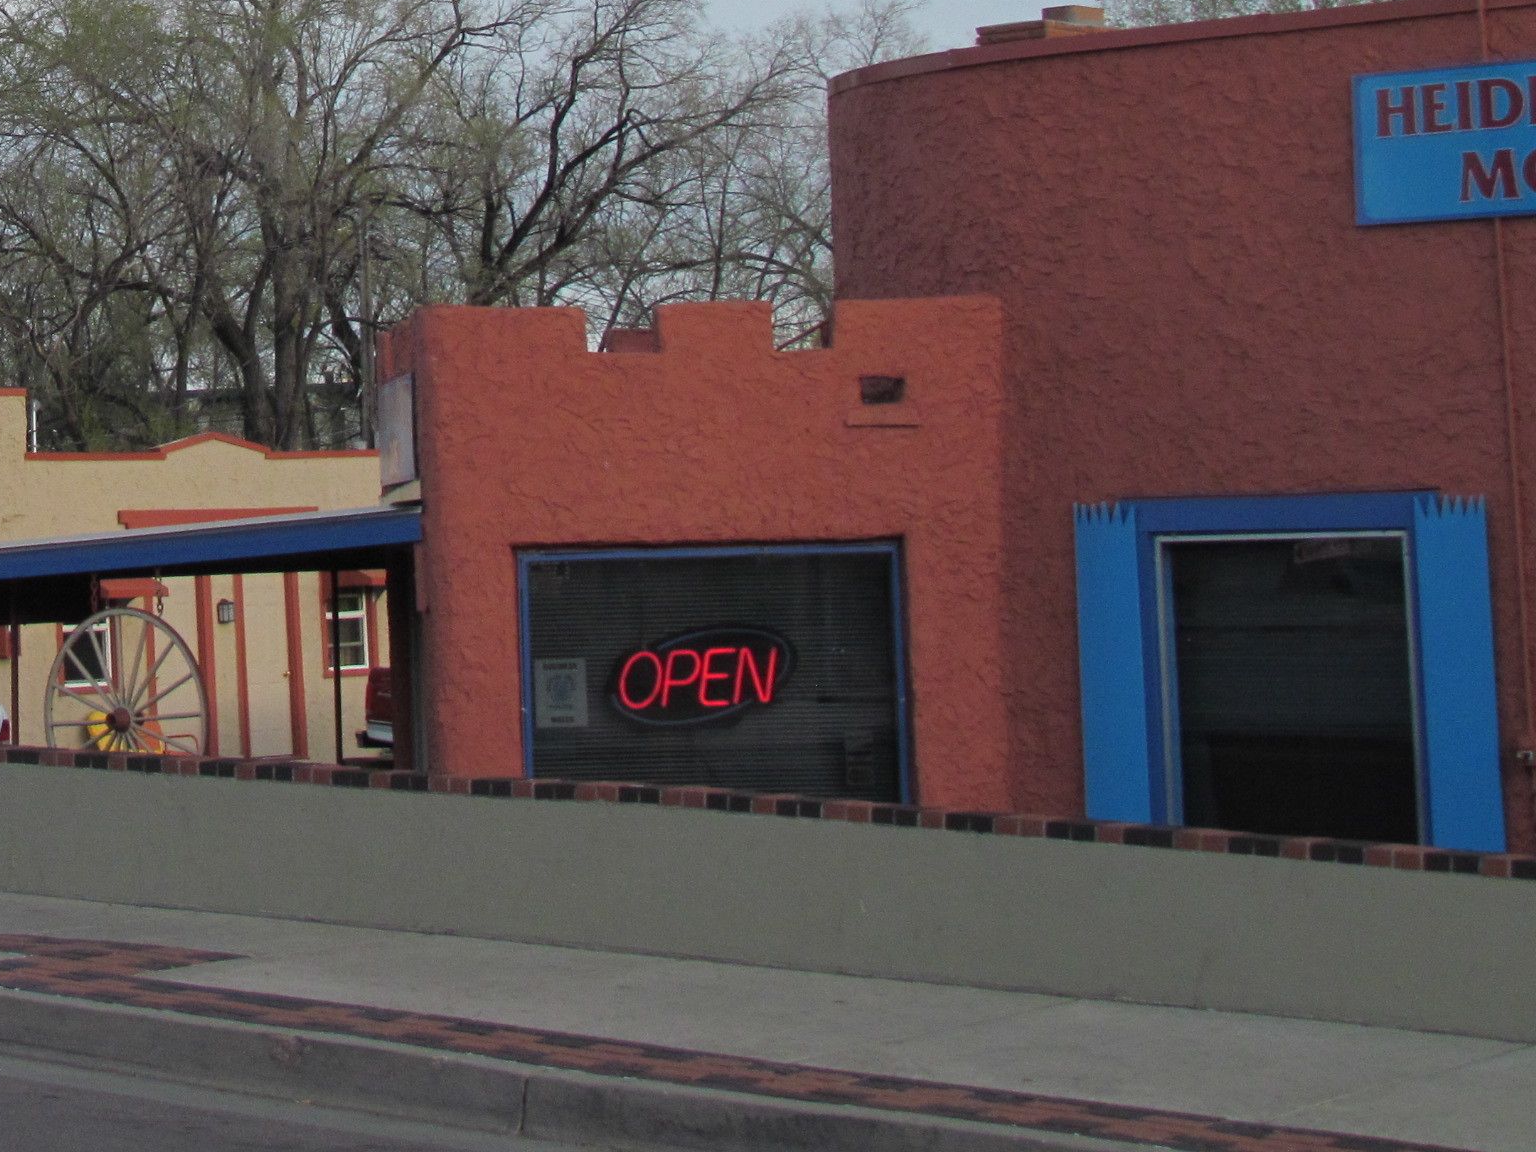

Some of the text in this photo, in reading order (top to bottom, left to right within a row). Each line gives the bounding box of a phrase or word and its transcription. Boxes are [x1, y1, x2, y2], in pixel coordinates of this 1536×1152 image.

[1376, 76, 1536, 138] HEID
[1460, 147, 1536, 203] M
[618, 646, 779, 710] OPEN
